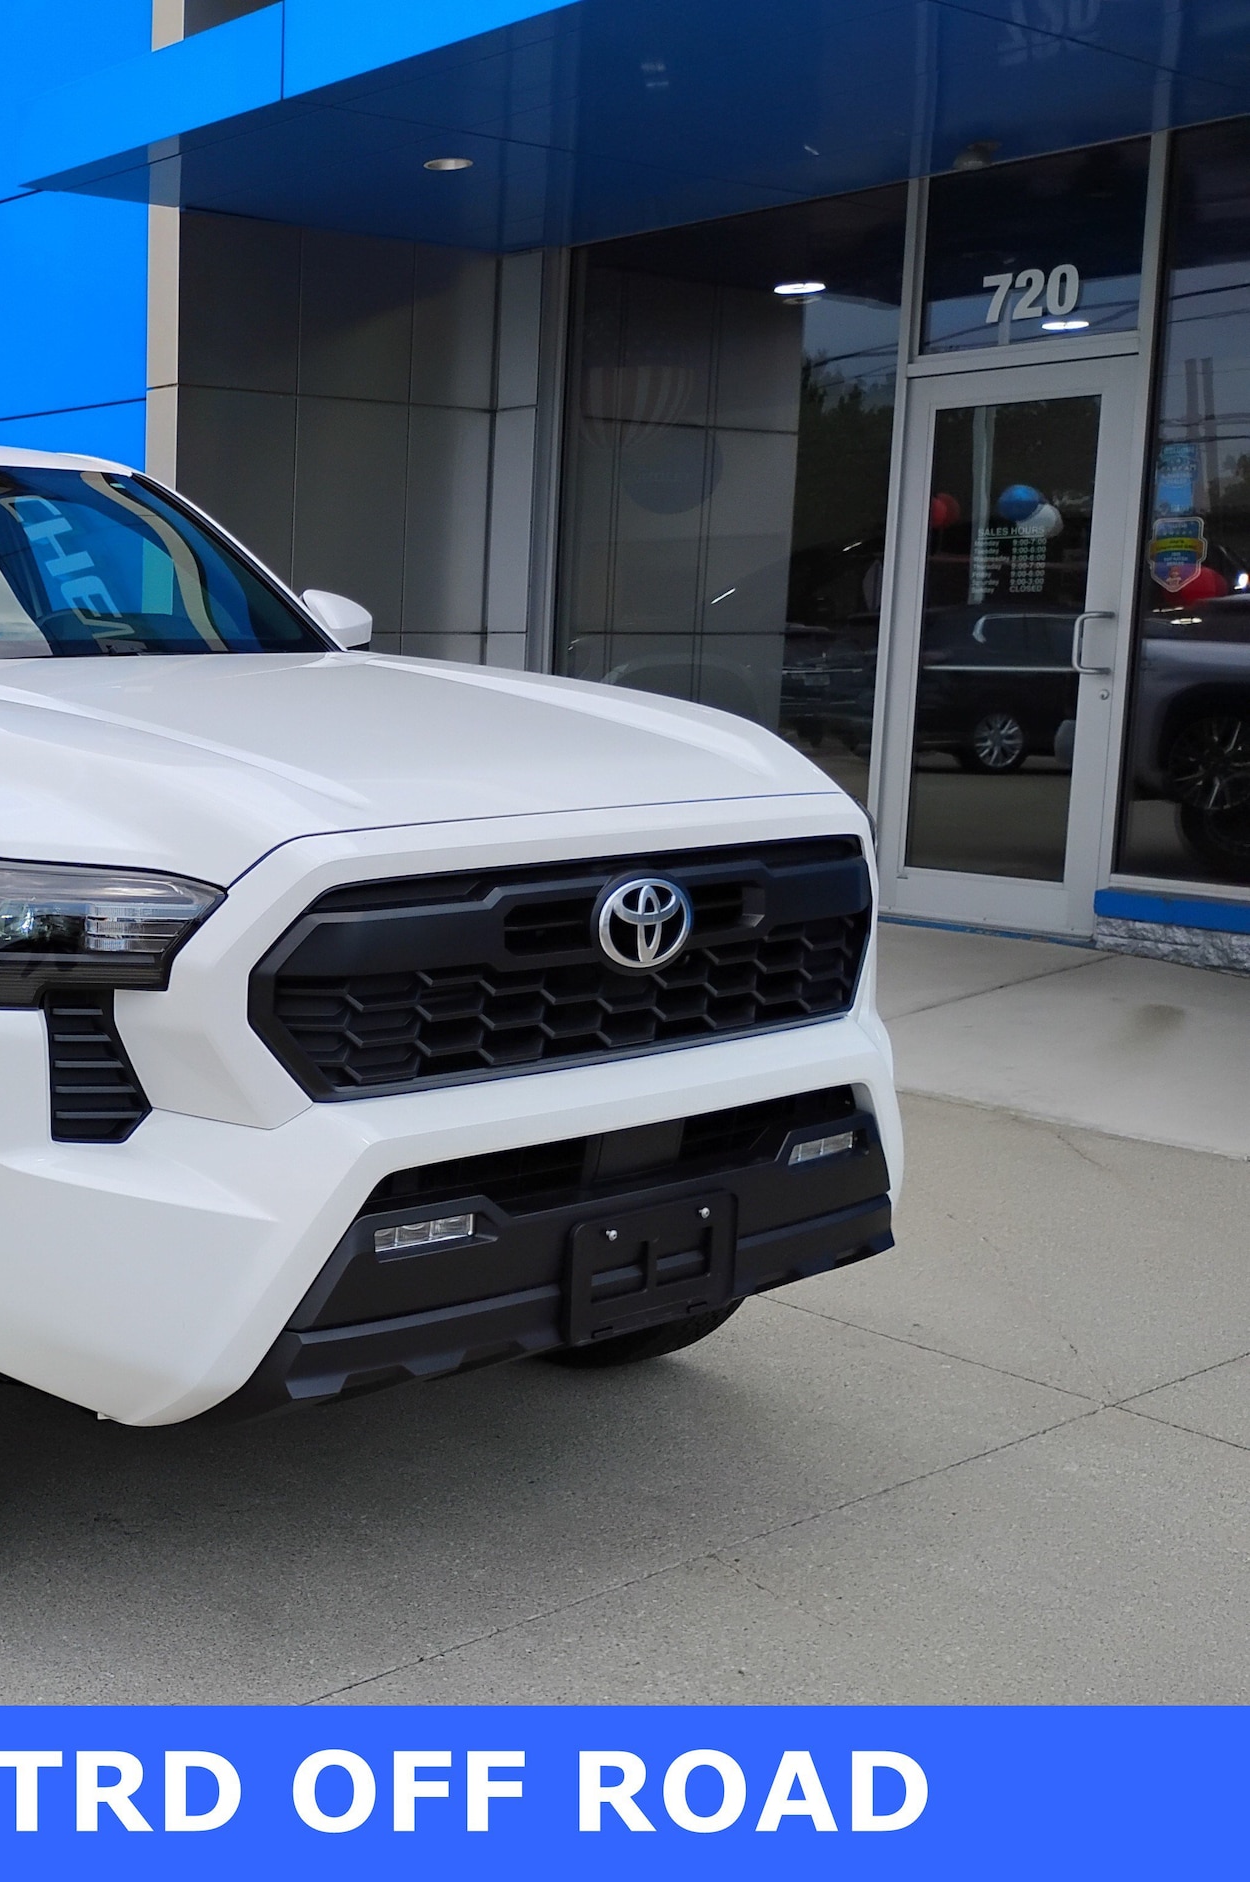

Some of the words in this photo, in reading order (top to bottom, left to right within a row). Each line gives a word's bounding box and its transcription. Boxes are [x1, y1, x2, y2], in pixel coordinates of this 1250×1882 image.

[982, 263, 1080, 323] 720
[978, 527, 1008, 537] SALES
[1011, 526, 1045, 536] HOURS
[1009, 585, 1043, 593] CLOSED
